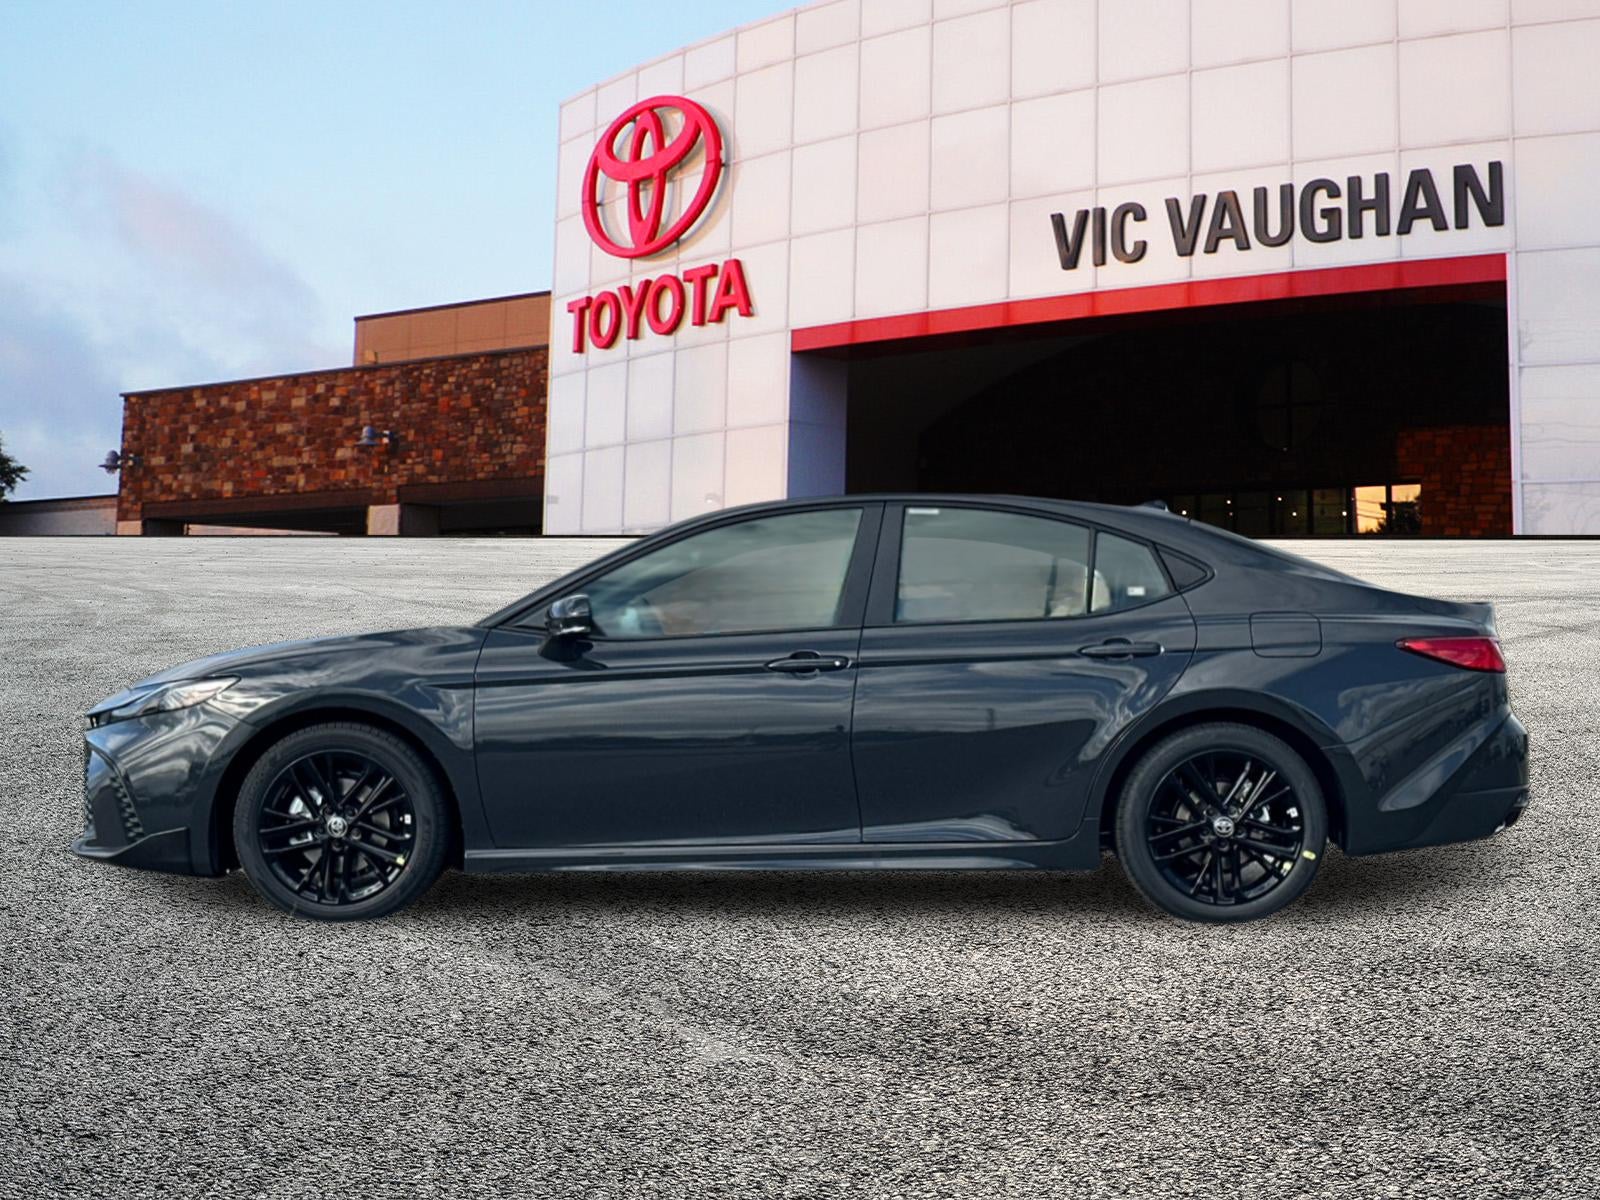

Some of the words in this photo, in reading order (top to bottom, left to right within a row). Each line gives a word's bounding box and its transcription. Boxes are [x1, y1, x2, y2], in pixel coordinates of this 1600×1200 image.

[1050, 201, 1147, 270] VIC
[1165, 160, 1505, 257] VAUGHAN
[567, 258, 754, 353] TOYOTA
